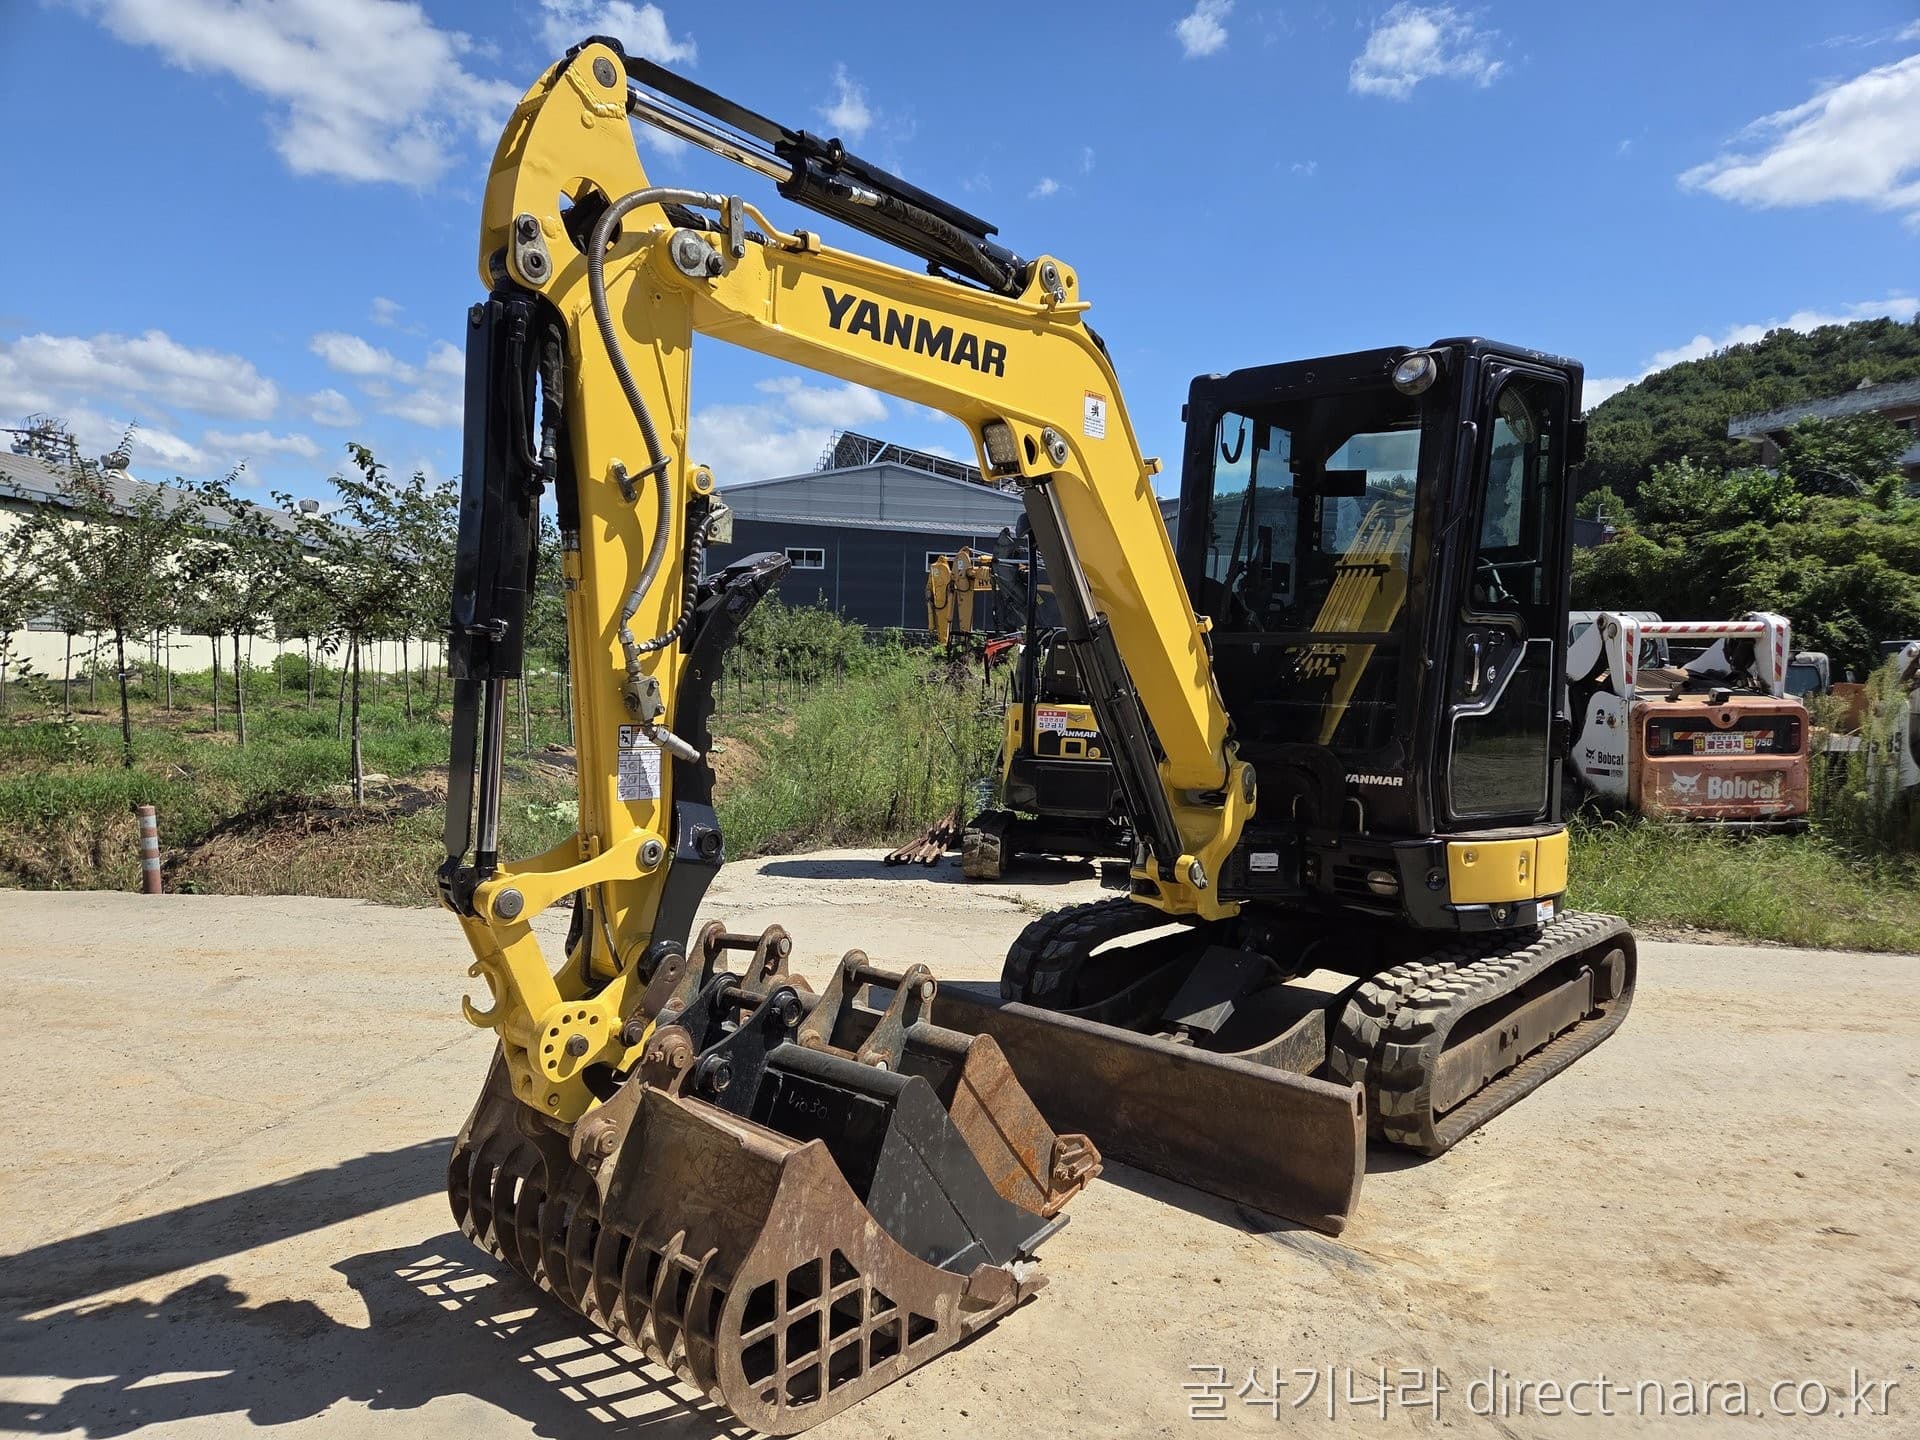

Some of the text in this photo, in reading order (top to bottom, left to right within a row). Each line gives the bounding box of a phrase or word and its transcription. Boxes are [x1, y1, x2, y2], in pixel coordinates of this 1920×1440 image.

[821, 285, 1007, 378] YANMAR
[1056, 730, 1097, 738] YANMAR
[1598, 751, 1624, 766] Bobcat
[1345, 773, 1404, 787] YANMAR
[1707, 771, 1781, 800] Bobcat
